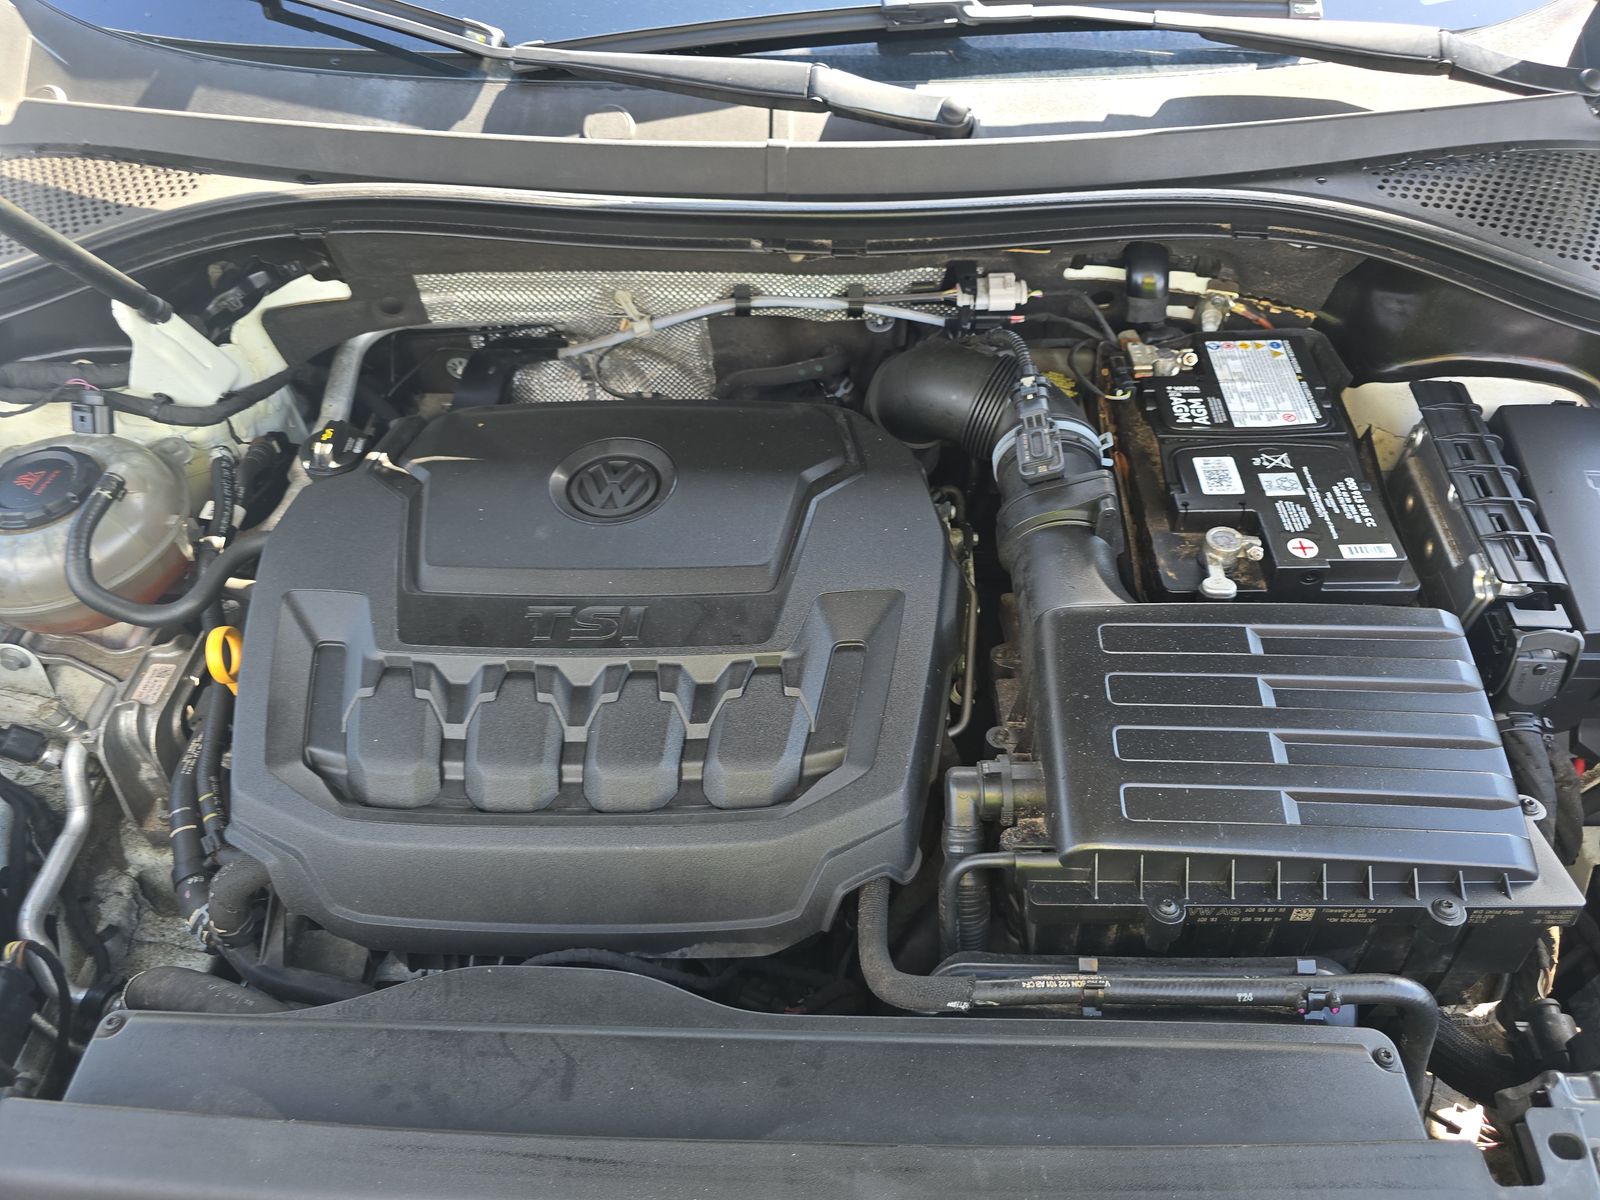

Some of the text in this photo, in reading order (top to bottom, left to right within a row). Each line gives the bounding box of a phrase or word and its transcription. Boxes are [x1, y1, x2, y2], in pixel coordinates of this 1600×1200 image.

[1169, 397, 1193, 423] AGM
[1187, 398, 1211, 425] AGM
[525, 605, 648, 640] TSI
